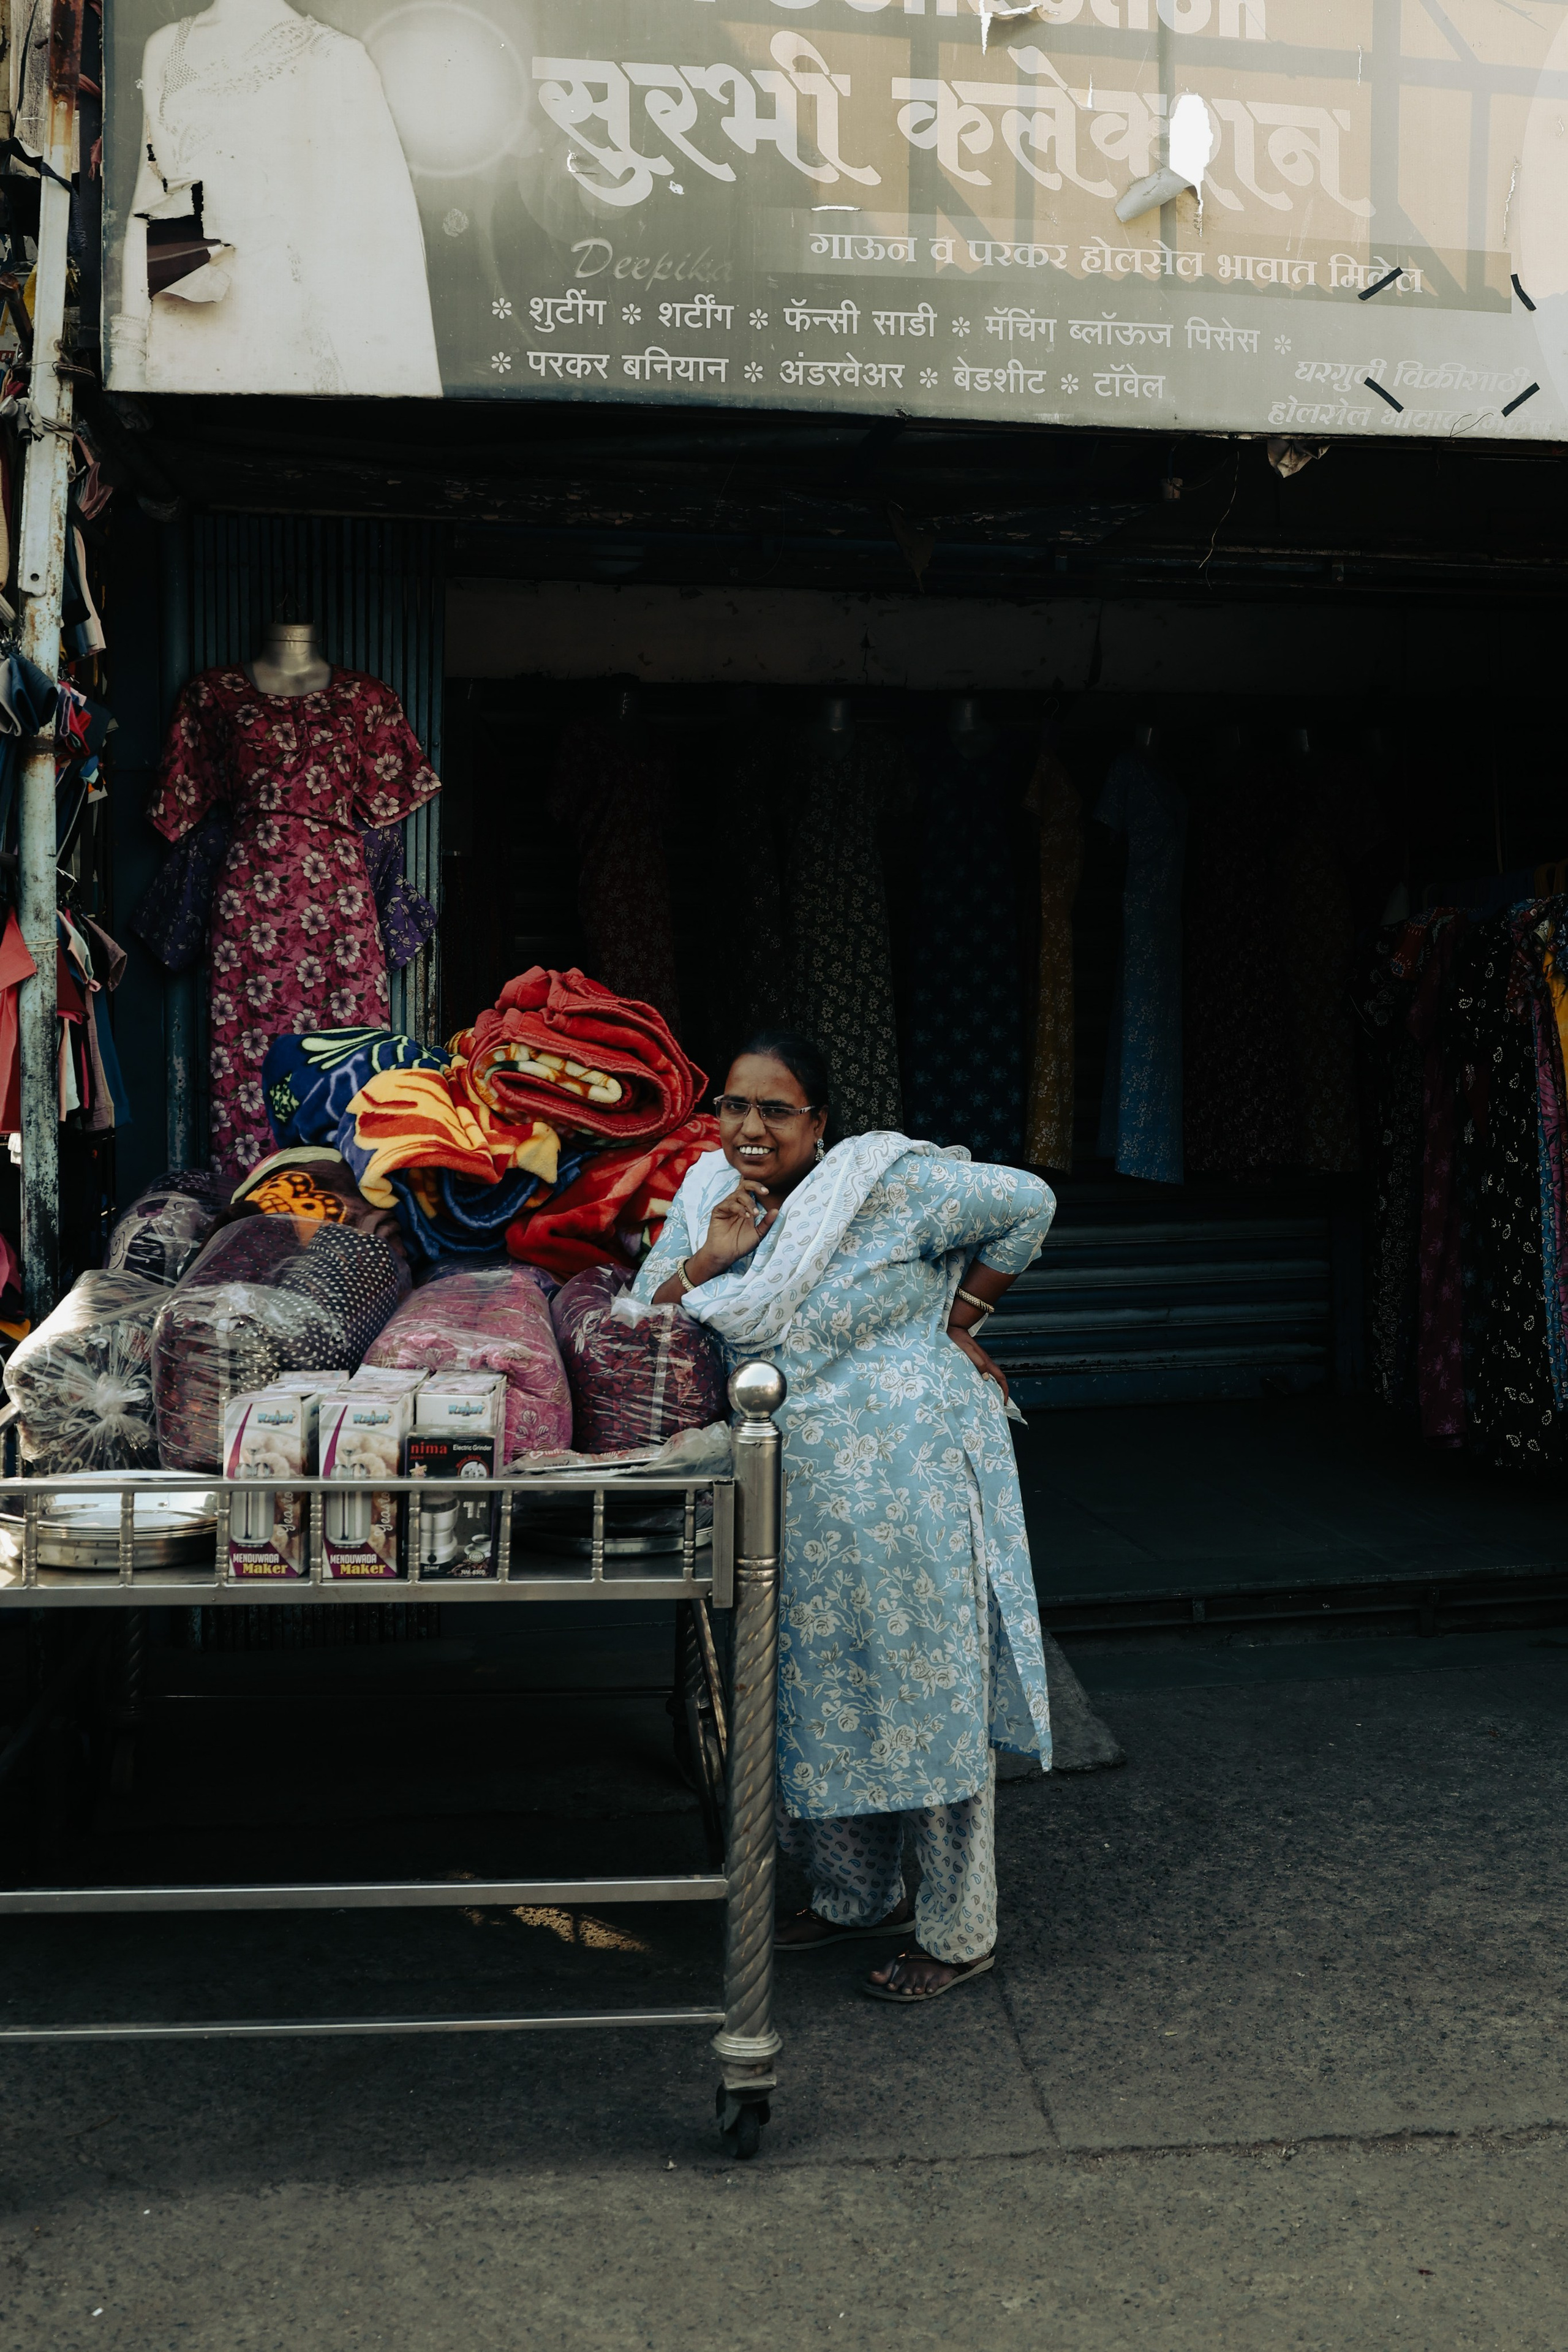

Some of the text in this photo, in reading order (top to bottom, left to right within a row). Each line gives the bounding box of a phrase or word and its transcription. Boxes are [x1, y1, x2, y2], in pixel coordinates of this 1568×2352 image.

[532, 30, 882, 206] सुरभी
[809, 233, 918, 262] गाऊन
[929, 238, 956, 264] व
[967, 240, 1068, 270] परकर
[1079, 236, 1205, 276] होलसेल
[1217, 254, 1317, 285] भावात
[783, 298, 860, 334] फॅन्सी
[872, 302, 937, 336] साडी
[1185, 317, 1260, 353] पिसेस
[527, 347, 1166, 399] परकर बनियान अंडरवेअर बेडशीट टॉवेल
[410, 1441, 448, 1454] nima
[233, 1553, 279, 1564] MENDUWADA
[330, 1554, 377, 1564] MENDUWADA
[243, 1563, 288, 1574] Maker
[340, 1564, 386, 1575] Maker
